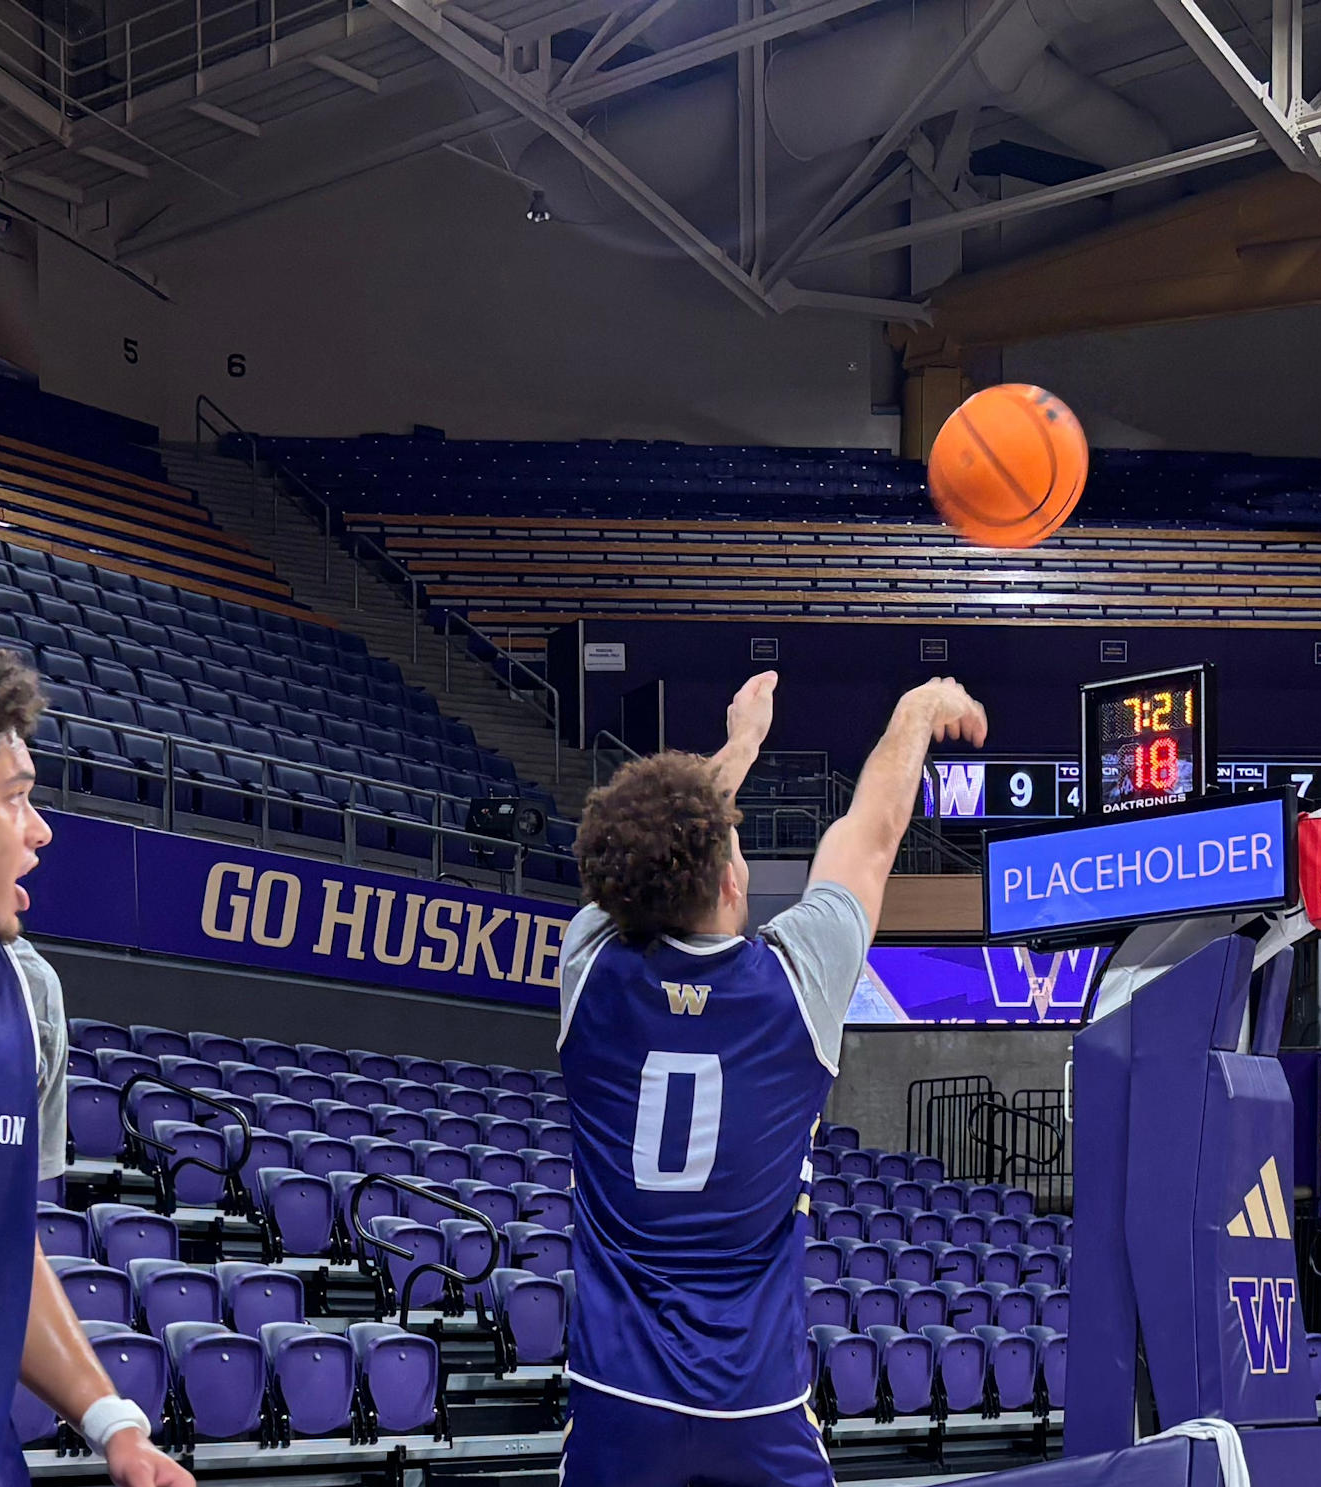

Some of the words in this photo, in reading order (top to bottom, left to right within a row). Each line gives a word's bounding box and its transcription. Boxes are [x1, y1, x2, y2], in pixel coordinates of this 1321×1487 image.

[123, 337, 138, 364] 5
[227, 353, 246, 378] 6
[1123, 688, 1193, 732] 7:21
[1060, 766, 1079, 776] TO
[1135, 737, 1178, 789] 18
[1237, 768, 1262, 777] TOL
[934, 765, 985, 816] W
[1009, 772, 1033, 807] 9
[1102, 793, 1187, 813] DAKTRONICS
[1290, 773, 1314, 798] 7
[1003, 832, 1273, 904] PLACEHOLDER
[200, 861, 302, 949] GO
[312, 878, 571, 988] HUSKIE
[660, 980, 712, 1016] W
[632, 1050, 724, 1192] 0
[1228, 1276, 1296, 1375] W
